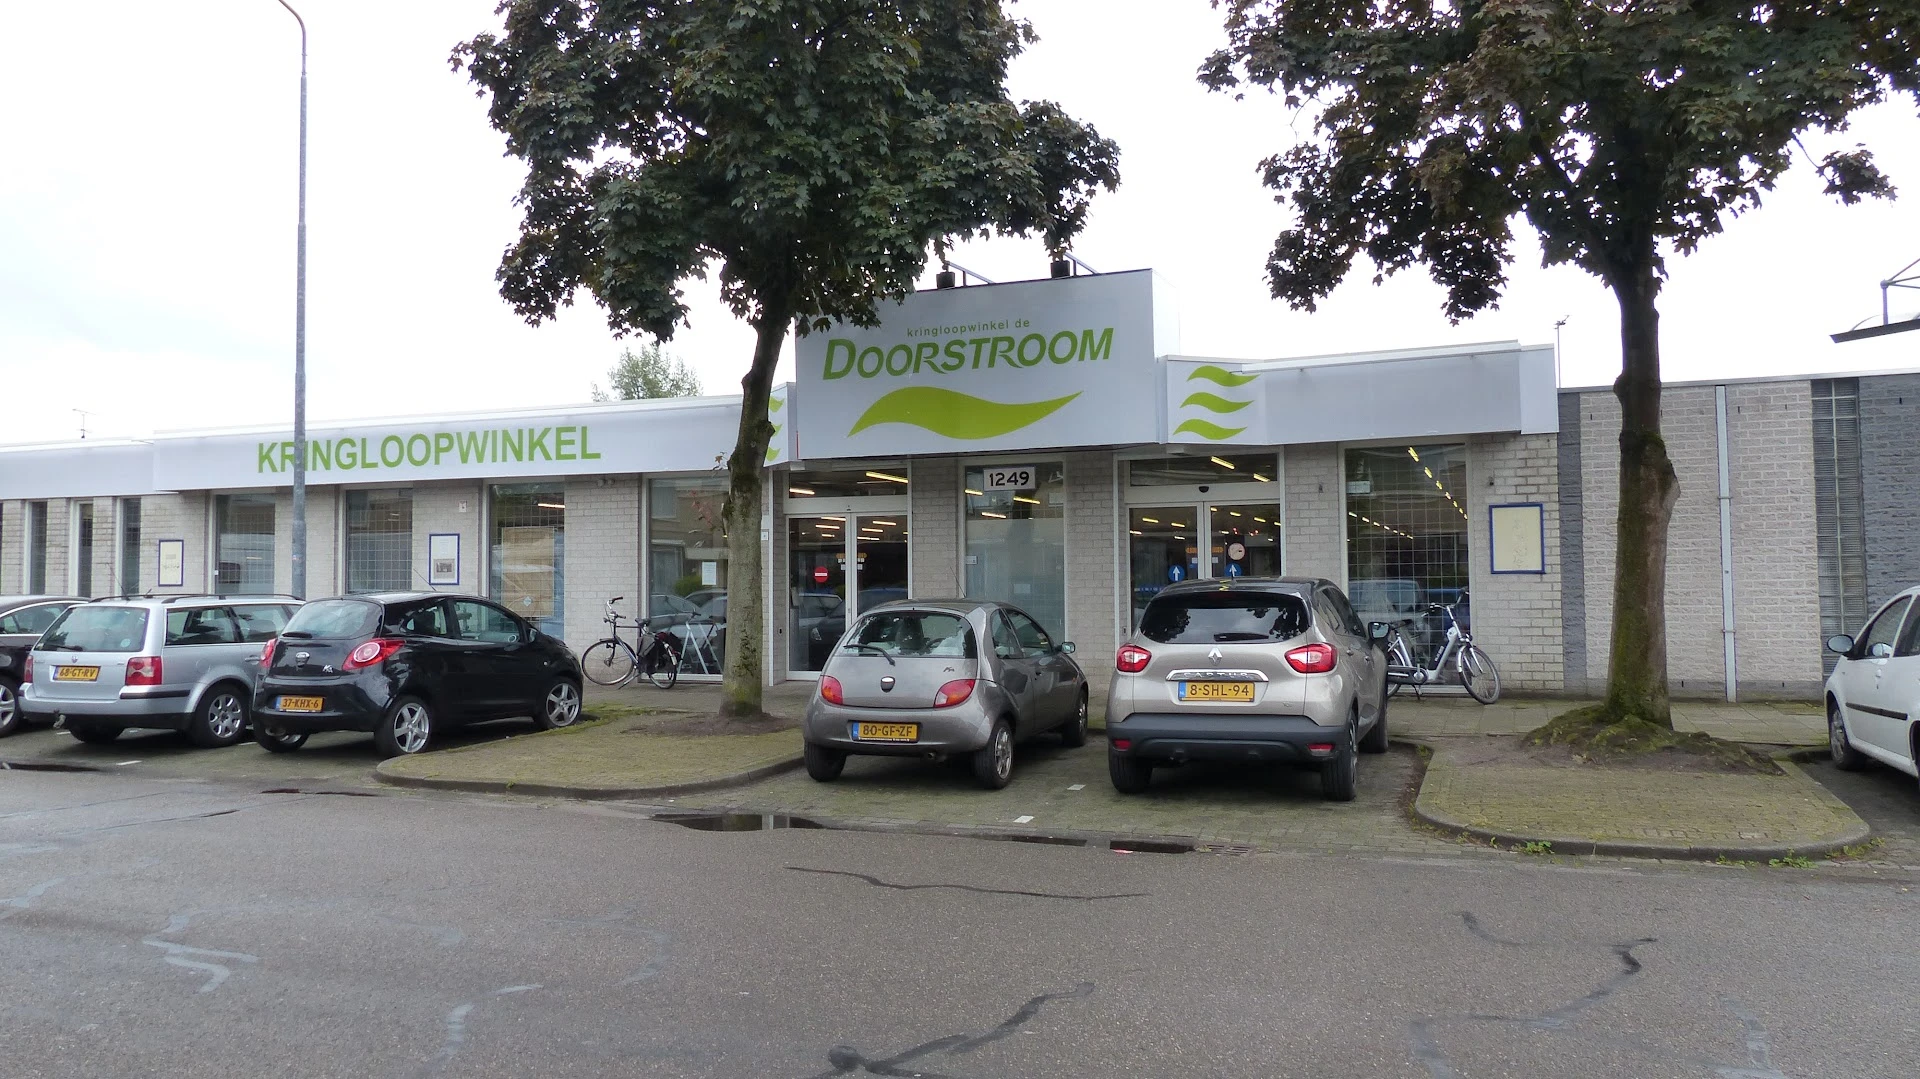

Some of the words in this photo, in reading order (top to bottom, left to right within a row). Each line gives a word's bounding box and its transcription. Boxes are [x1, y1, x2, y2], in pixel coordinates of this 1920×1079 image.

[907, 319, 1009, 338] kringloopwinkel
[1014, 318, 1031, 329] de
[822, 327, 1114, 381] DOORSTROOM
[257, 426, 601, 474] KRINGLOOPWINKEL
[989, 470, 1030, 487] 1249
[59, 666, 96, 678] 68-GT-RV
[1189, 684, 1250, 697] 8-SHL-94
[282, 697, 319, 709] 37-KHX-6
[862, 724, 913, 738] 80-GF-ZF
